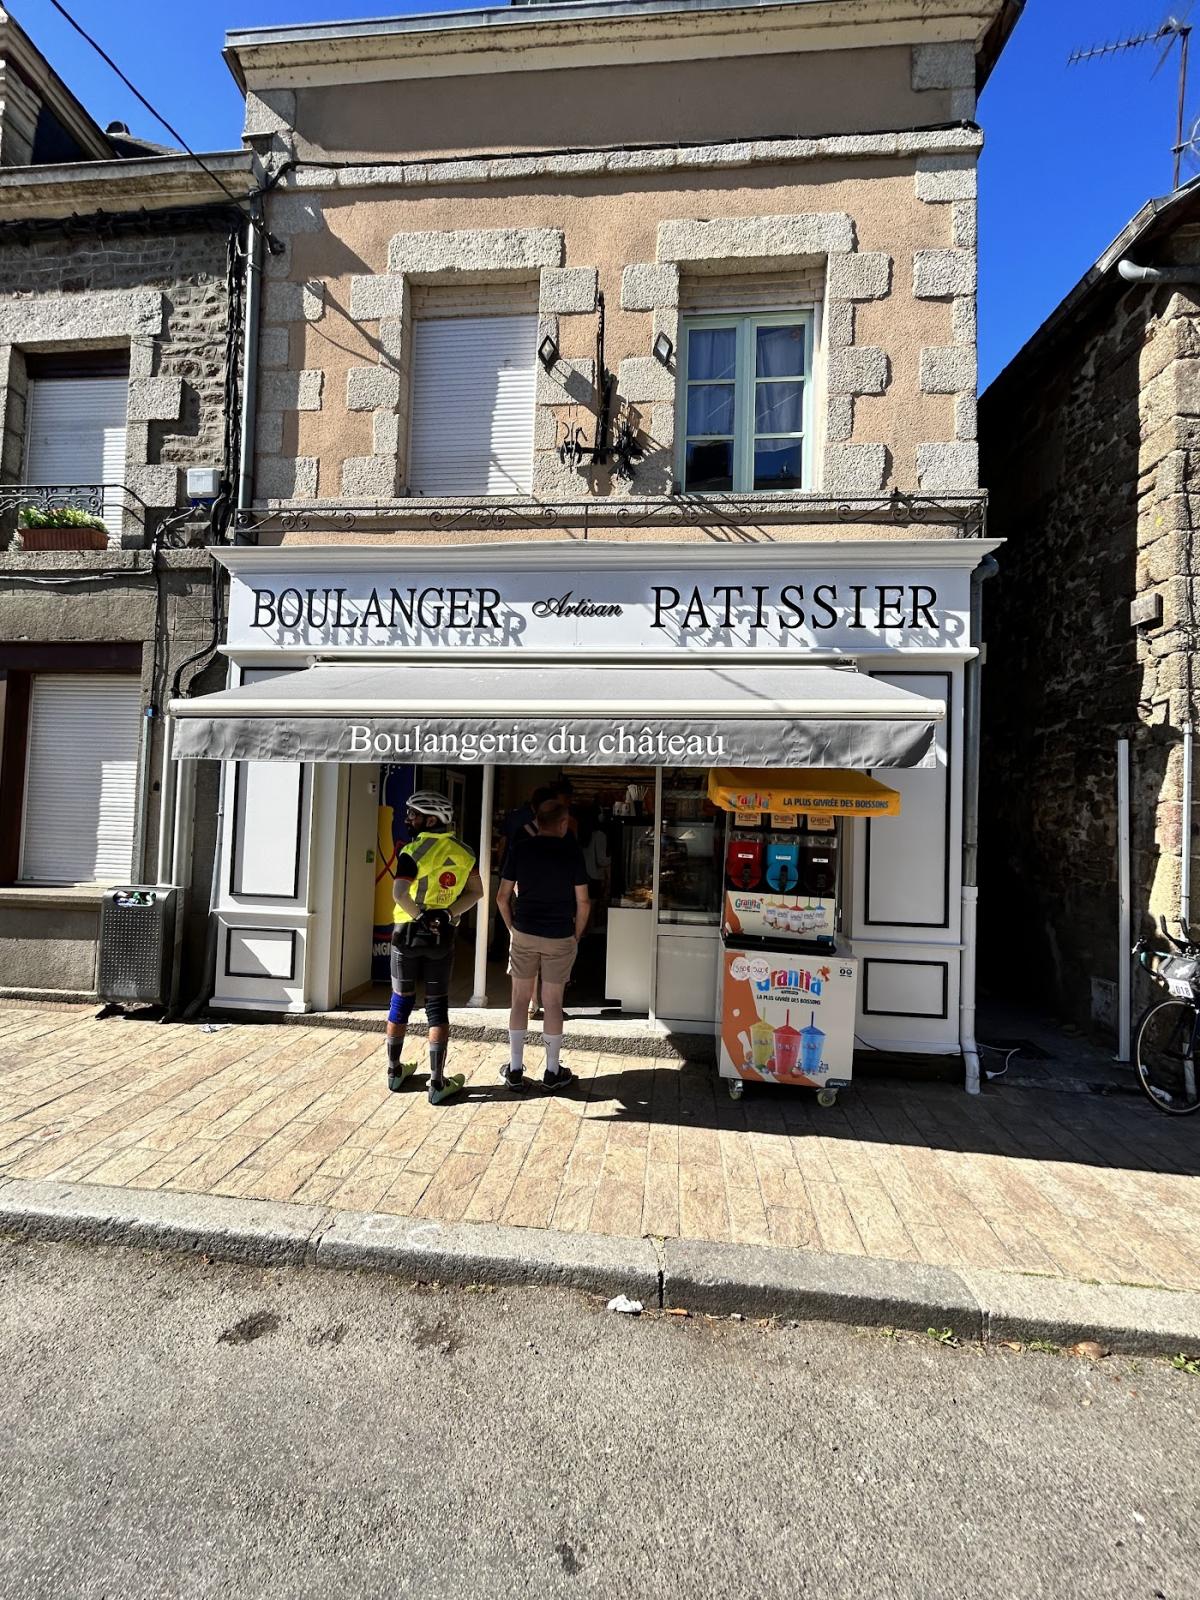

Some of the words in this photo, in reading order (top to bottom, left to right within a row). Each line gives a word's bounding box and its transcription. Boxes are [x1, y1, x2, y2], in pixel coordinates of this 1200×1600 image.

[249, 587, 503, 629] BOULANGER
[531, 590, 624, 618] Artisan
[649, 584, 941, 629] PATISSIER
[347, 724, 539, 761] Boulangerie
[547, 726, 588, 755] du
[597, 726, 726, 756] château
[783, 797, 793, 806] LA
[794, 797, 811, 806] PLUS
[812, 797, 839, 807] GIVRÉE
[840, 799, 854, 808] DES
[855, 799, 889, 809] BOISSONS
